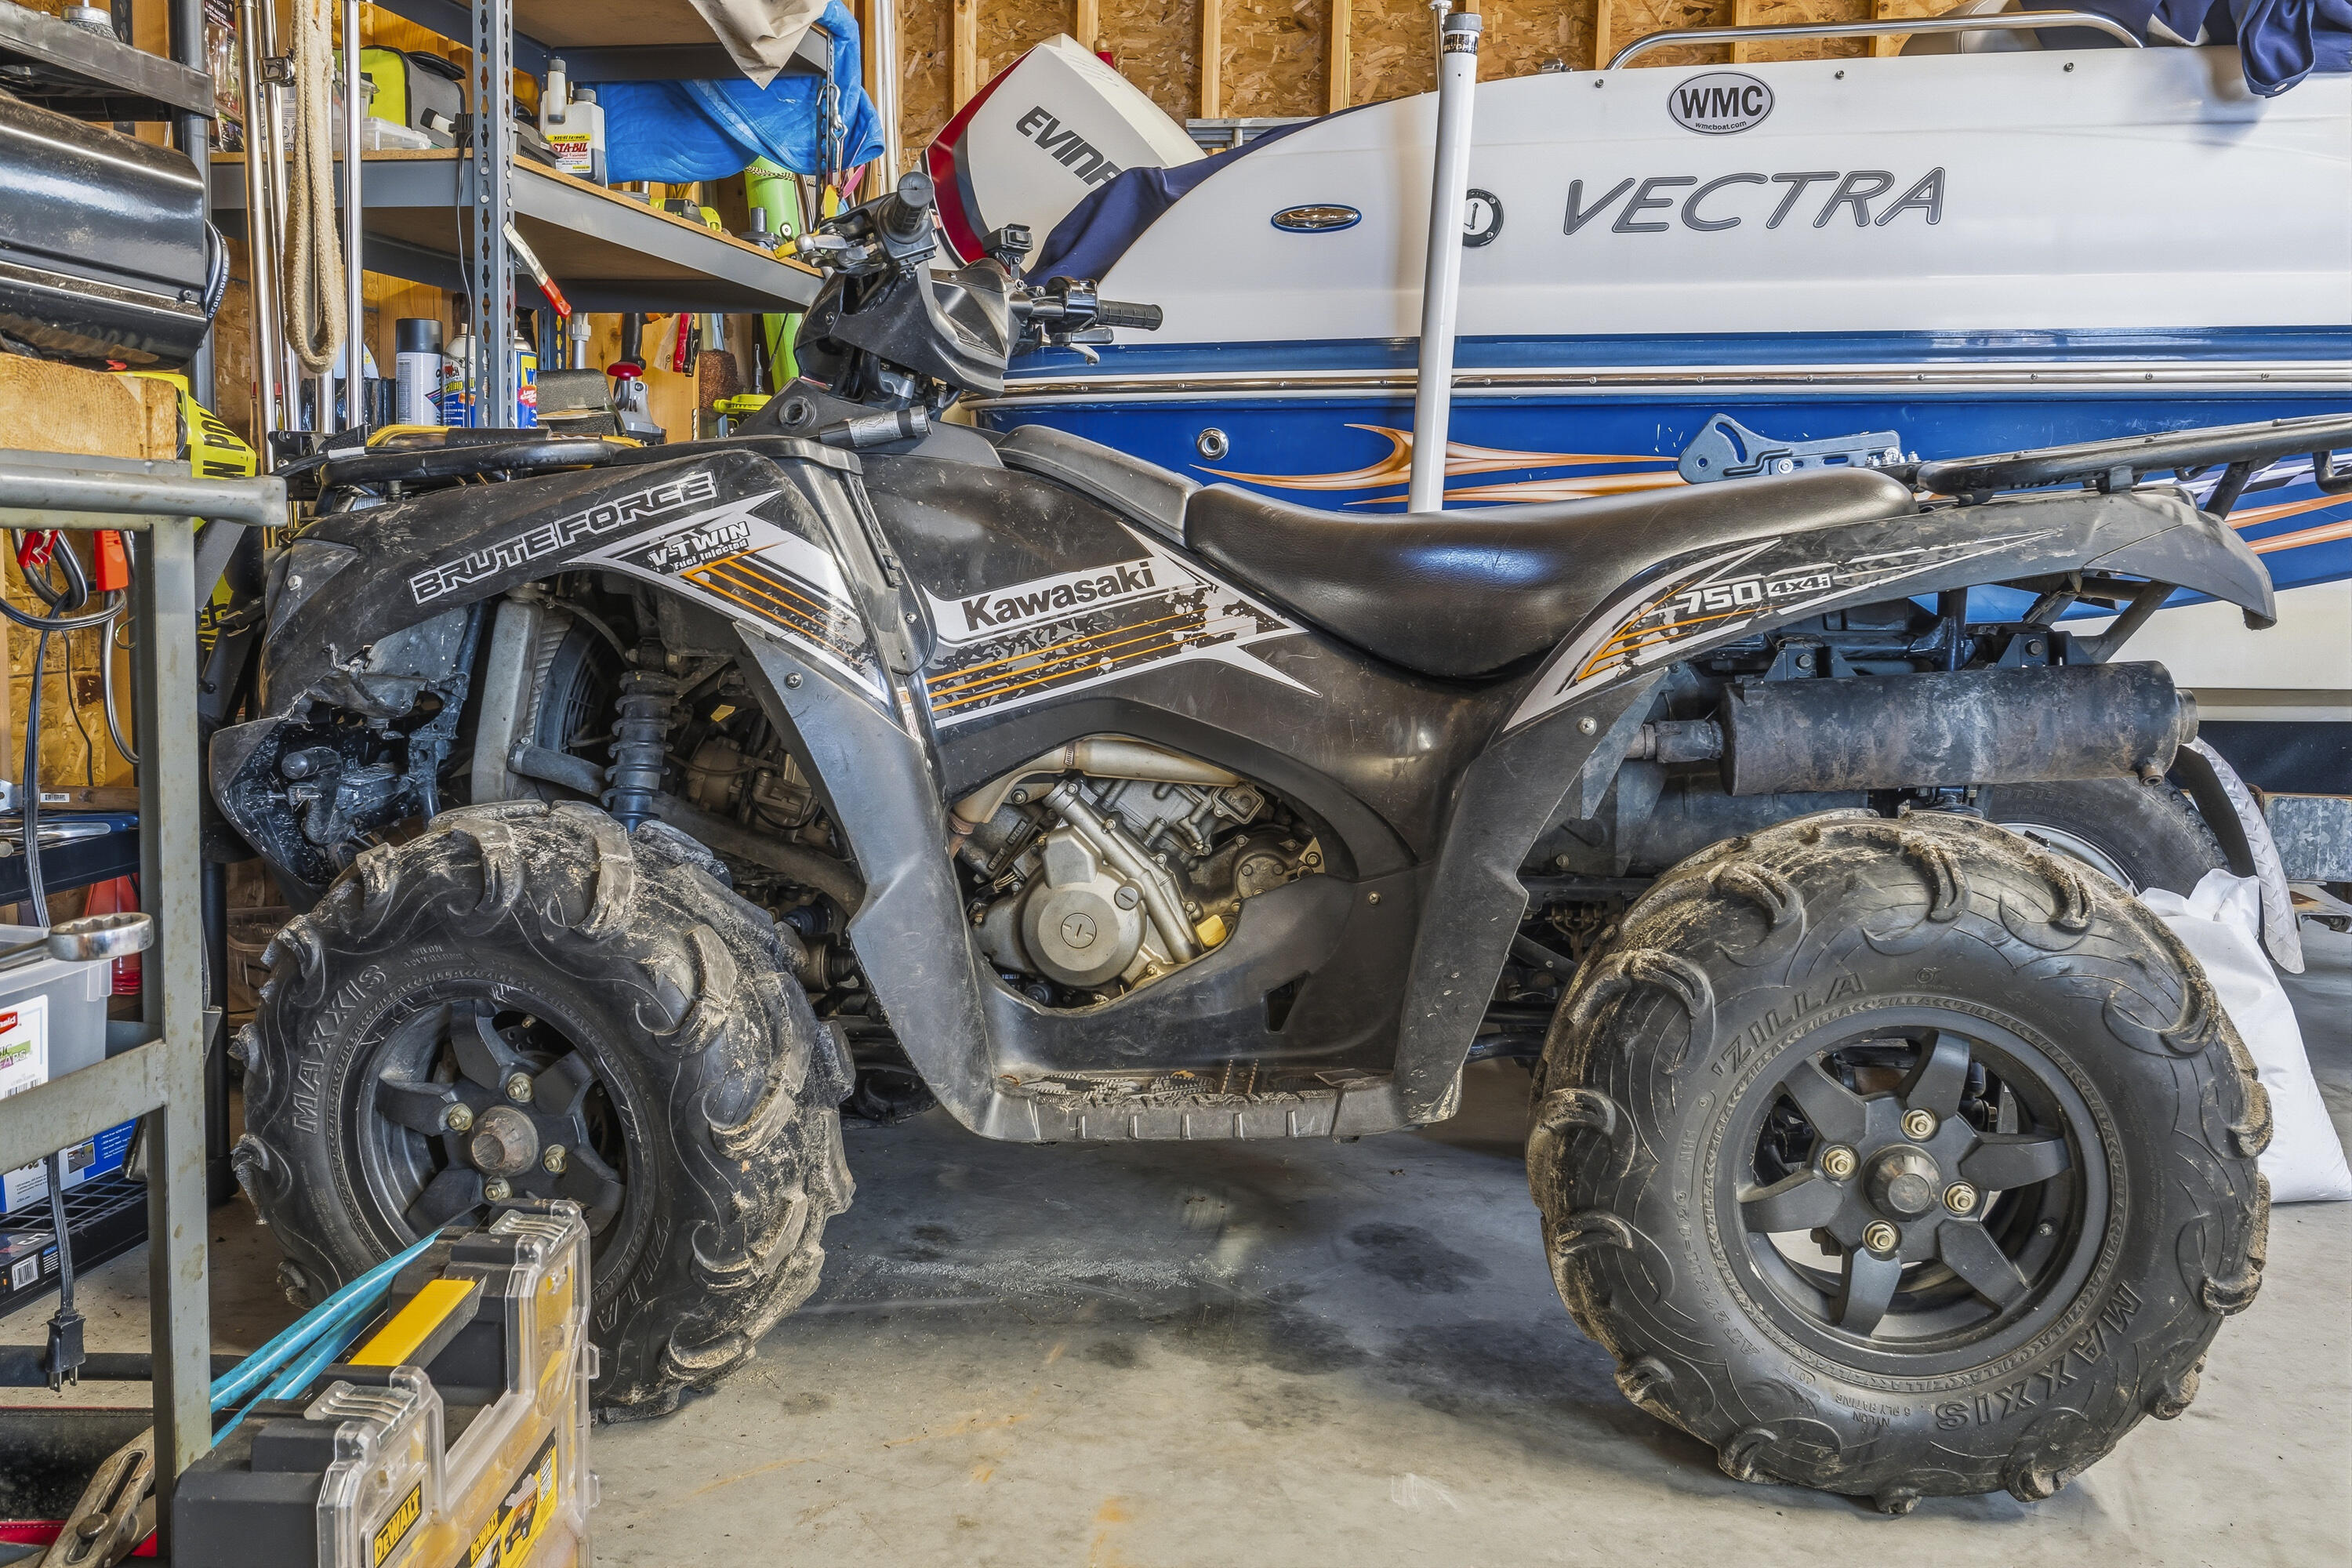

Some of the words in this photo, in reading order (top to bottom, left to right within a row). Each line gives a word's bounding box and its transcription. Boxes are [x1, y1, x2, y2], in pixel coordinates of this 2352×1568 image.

[1679, 85, 1762, 118] WMC
[1695, 121, 1747, 130] wmcboat.com
[1563, 167, 1945, 235] VECTRA
[409, 522, 558, 606] BRUTE
[555, 470, 719, 546] FORCE
[648, 521, 750, 566] V-TWIN
[700, 539, 749, 561] Injected
[962, 561, 1156, 632] Kawasaki
[1675, 580, 1763, 614] 750
[292, 964, 387, 1134] MAXXIS
[1936, 1279, 2145, 1432] MAXXIS
[1852, 1411, 1890, 1428] NYLON
[374, 1486, 421, 1564] DEWALT
